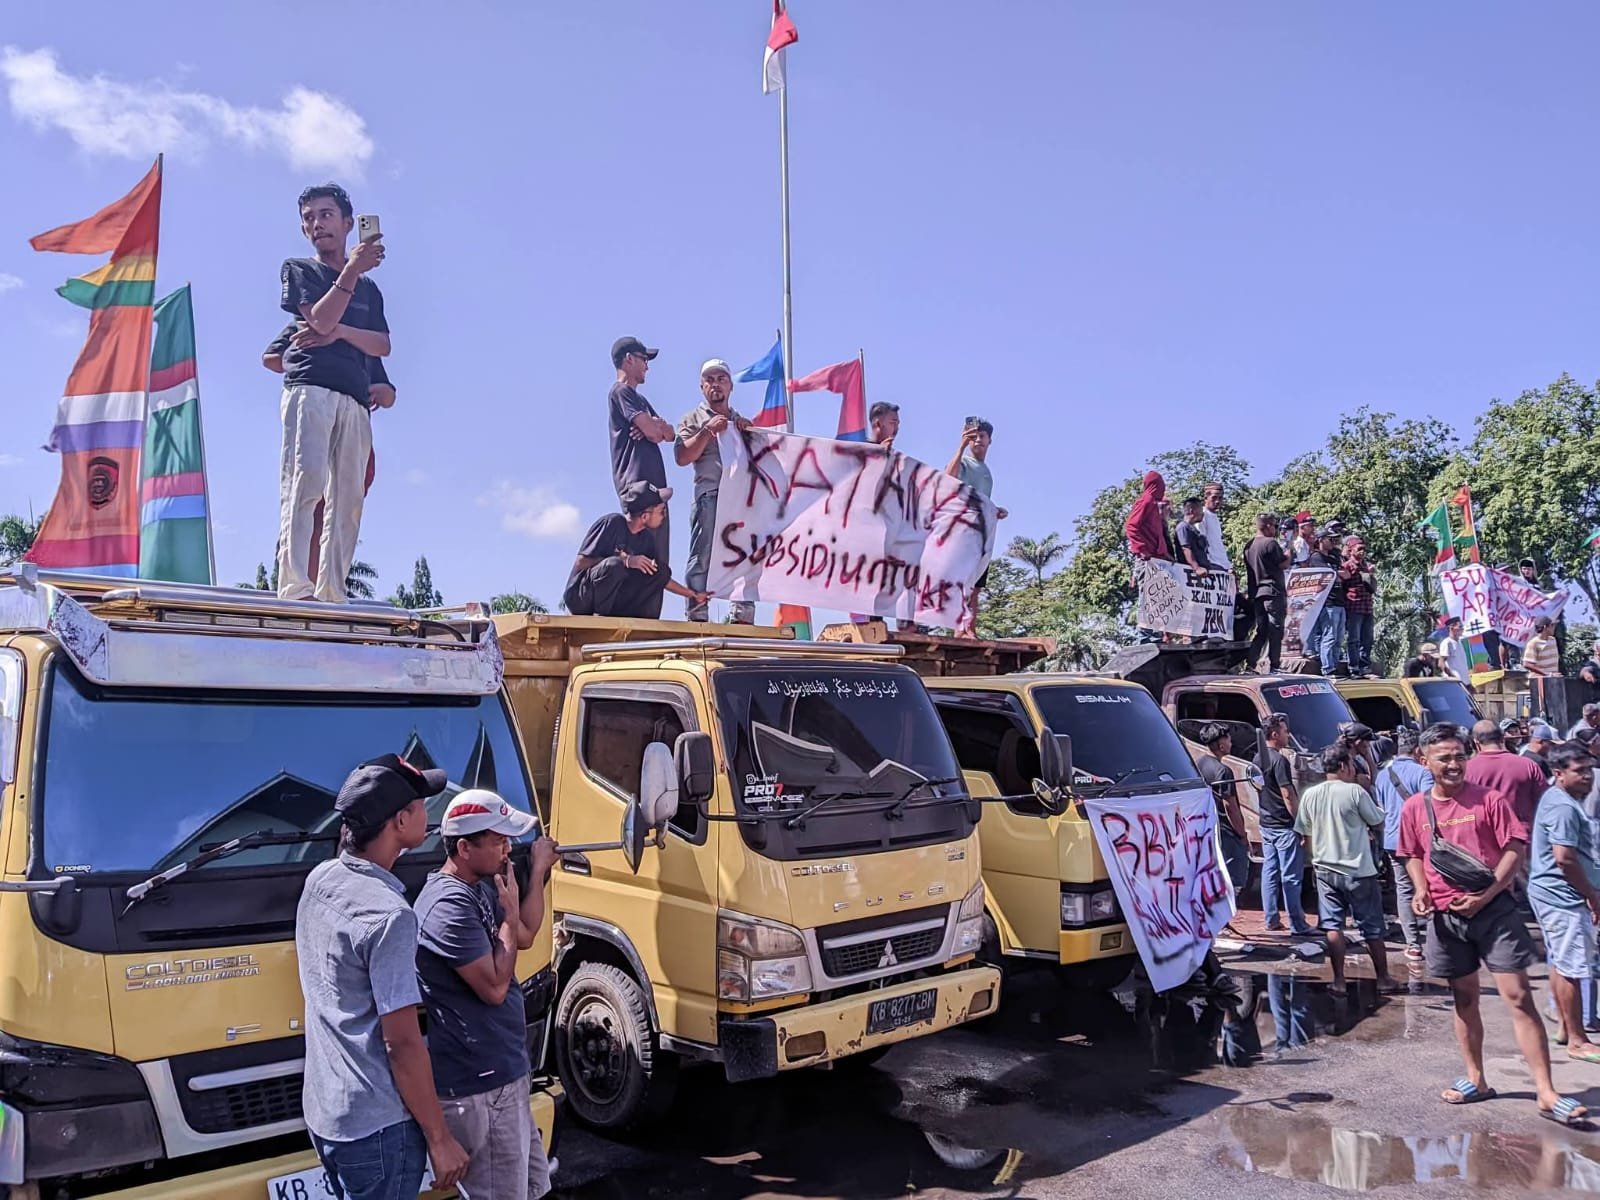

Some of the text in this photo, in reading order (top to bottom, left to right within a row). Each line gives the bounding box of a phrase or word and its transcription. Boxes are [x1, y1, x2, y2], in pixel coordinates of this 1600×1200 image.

[744, 783, 785, 797] PRO7
[872, 1001, 886, 1023] KB
[890, 995, 916, 1017] 8277
[275, 1178, 309, 1200] KB
